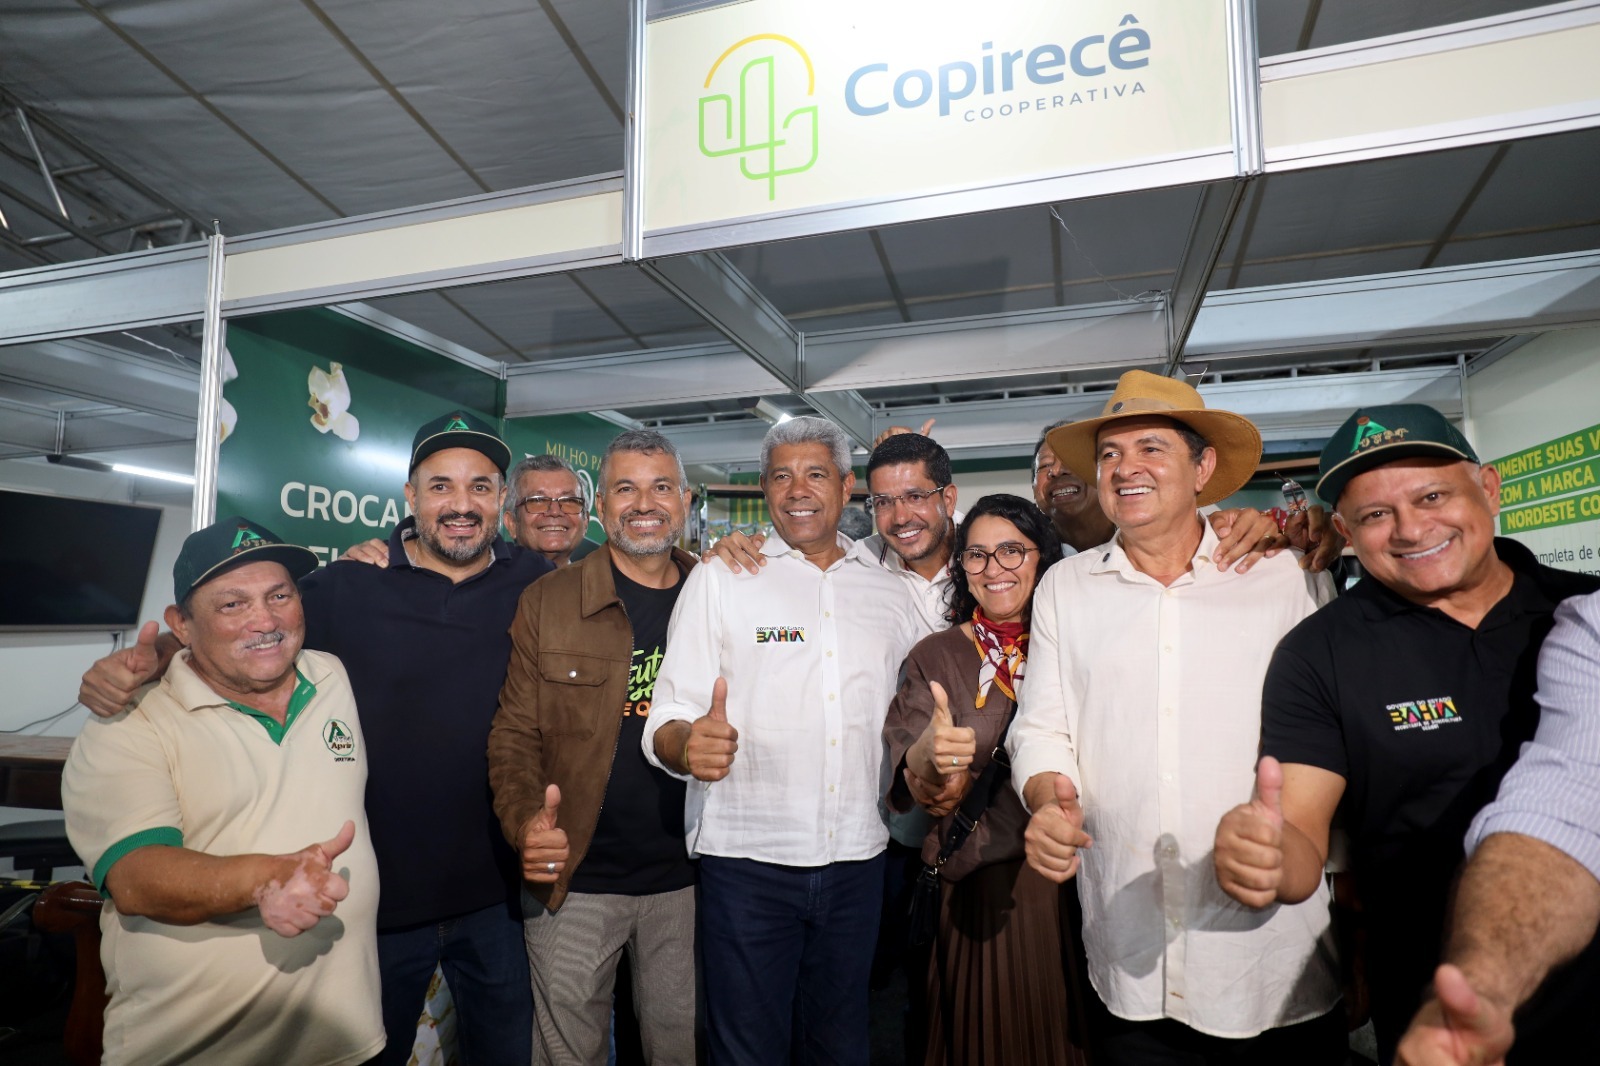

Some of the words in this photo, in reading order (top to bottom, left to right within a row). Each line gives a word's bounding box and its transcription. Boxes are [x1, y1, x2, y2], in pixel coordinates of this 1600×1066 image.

[844, 13, 1151, 117] Copirecê
[963, 81, 1146, 122] COOPERATIVA
[546, 440, 588, 467] MILHO
[1494, 449, 1543, 478] UMENTE
[1546, 436, 1584, 465] SUAS
[1527, 481, 1537, 499] A
[1540, 465, 1595, 495] MARCA
[1506, 500, 1576, 530] NORDESTE
[1580, 494, 1600, 516] CO
[1579, 545, 1593, 560] de
